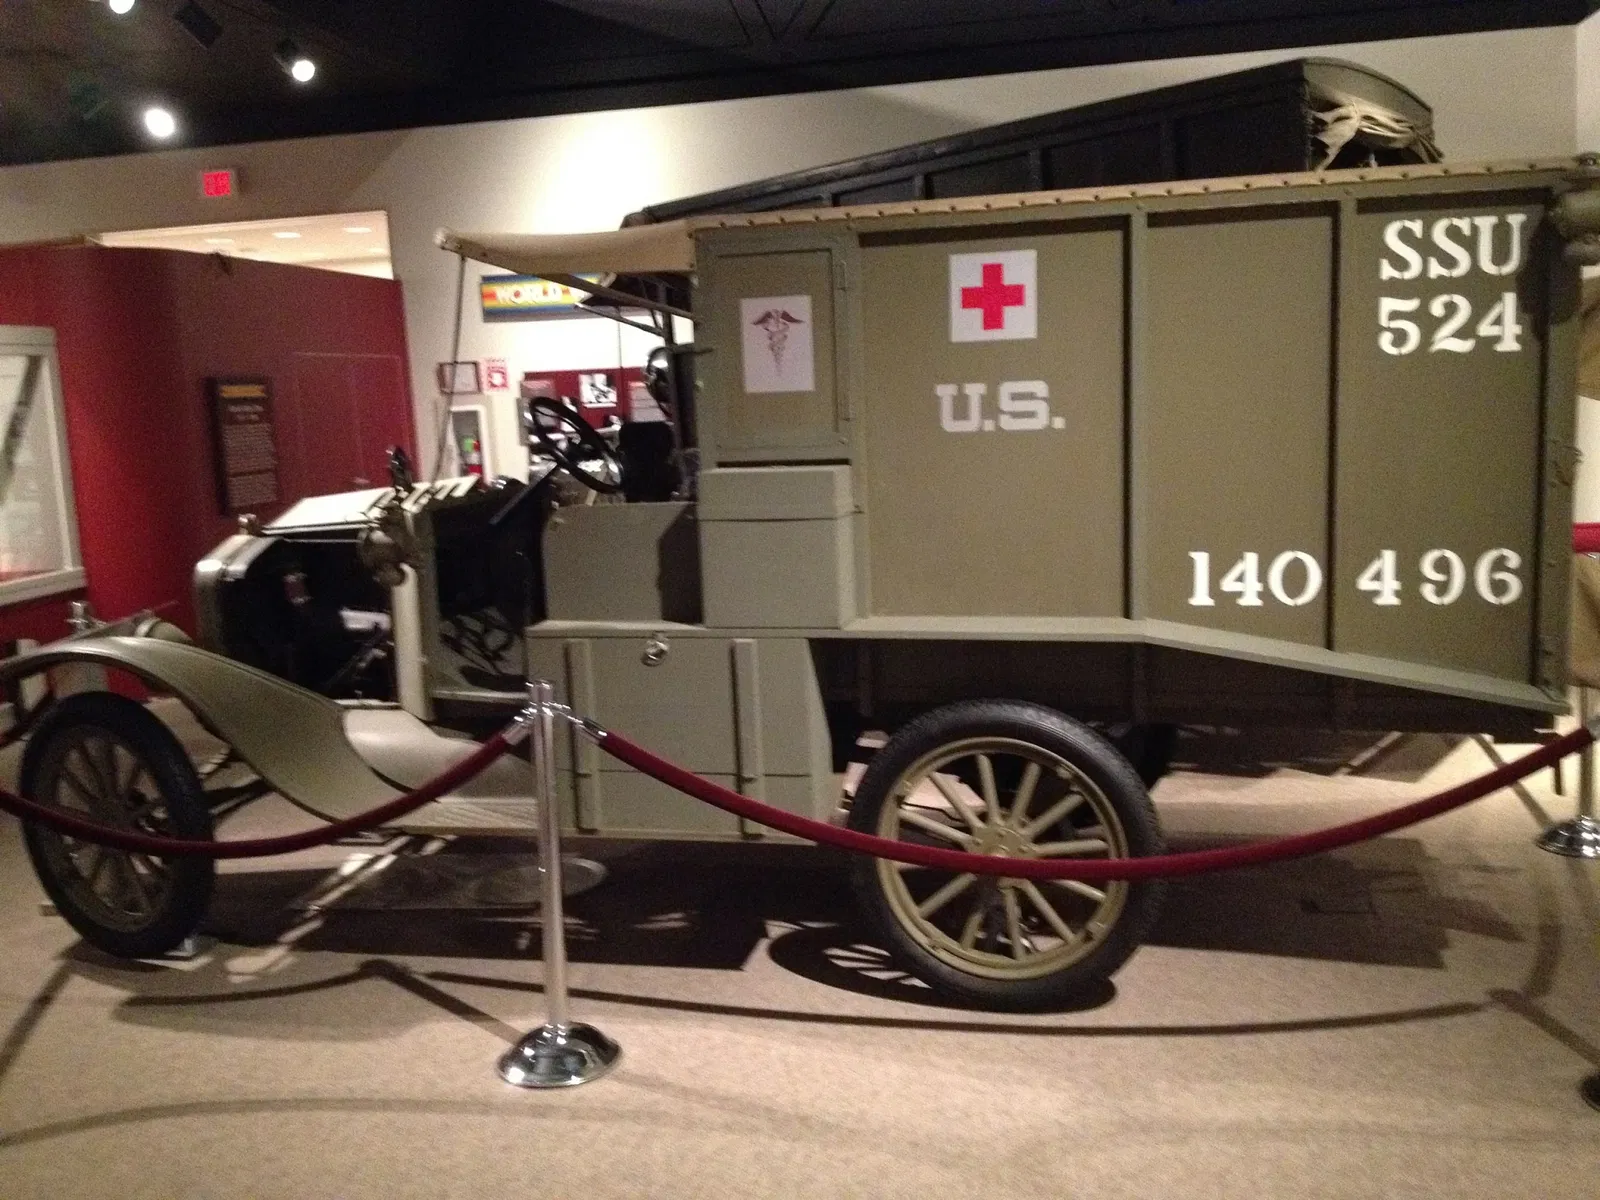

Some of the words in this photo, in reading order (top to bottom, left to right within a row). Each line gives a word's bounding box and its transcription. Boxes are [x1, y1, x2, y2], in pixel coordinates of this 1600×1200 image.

[1379, 213, 1527, 280] SSU
[496, 282, 563, 305] WORLD
[1377, 292, 1522, 356] 524
[934, 380, 1066, 433] U.S.
[1187, 550, 1323, 607] 140
[1356, 548, 1523, 606] 496
